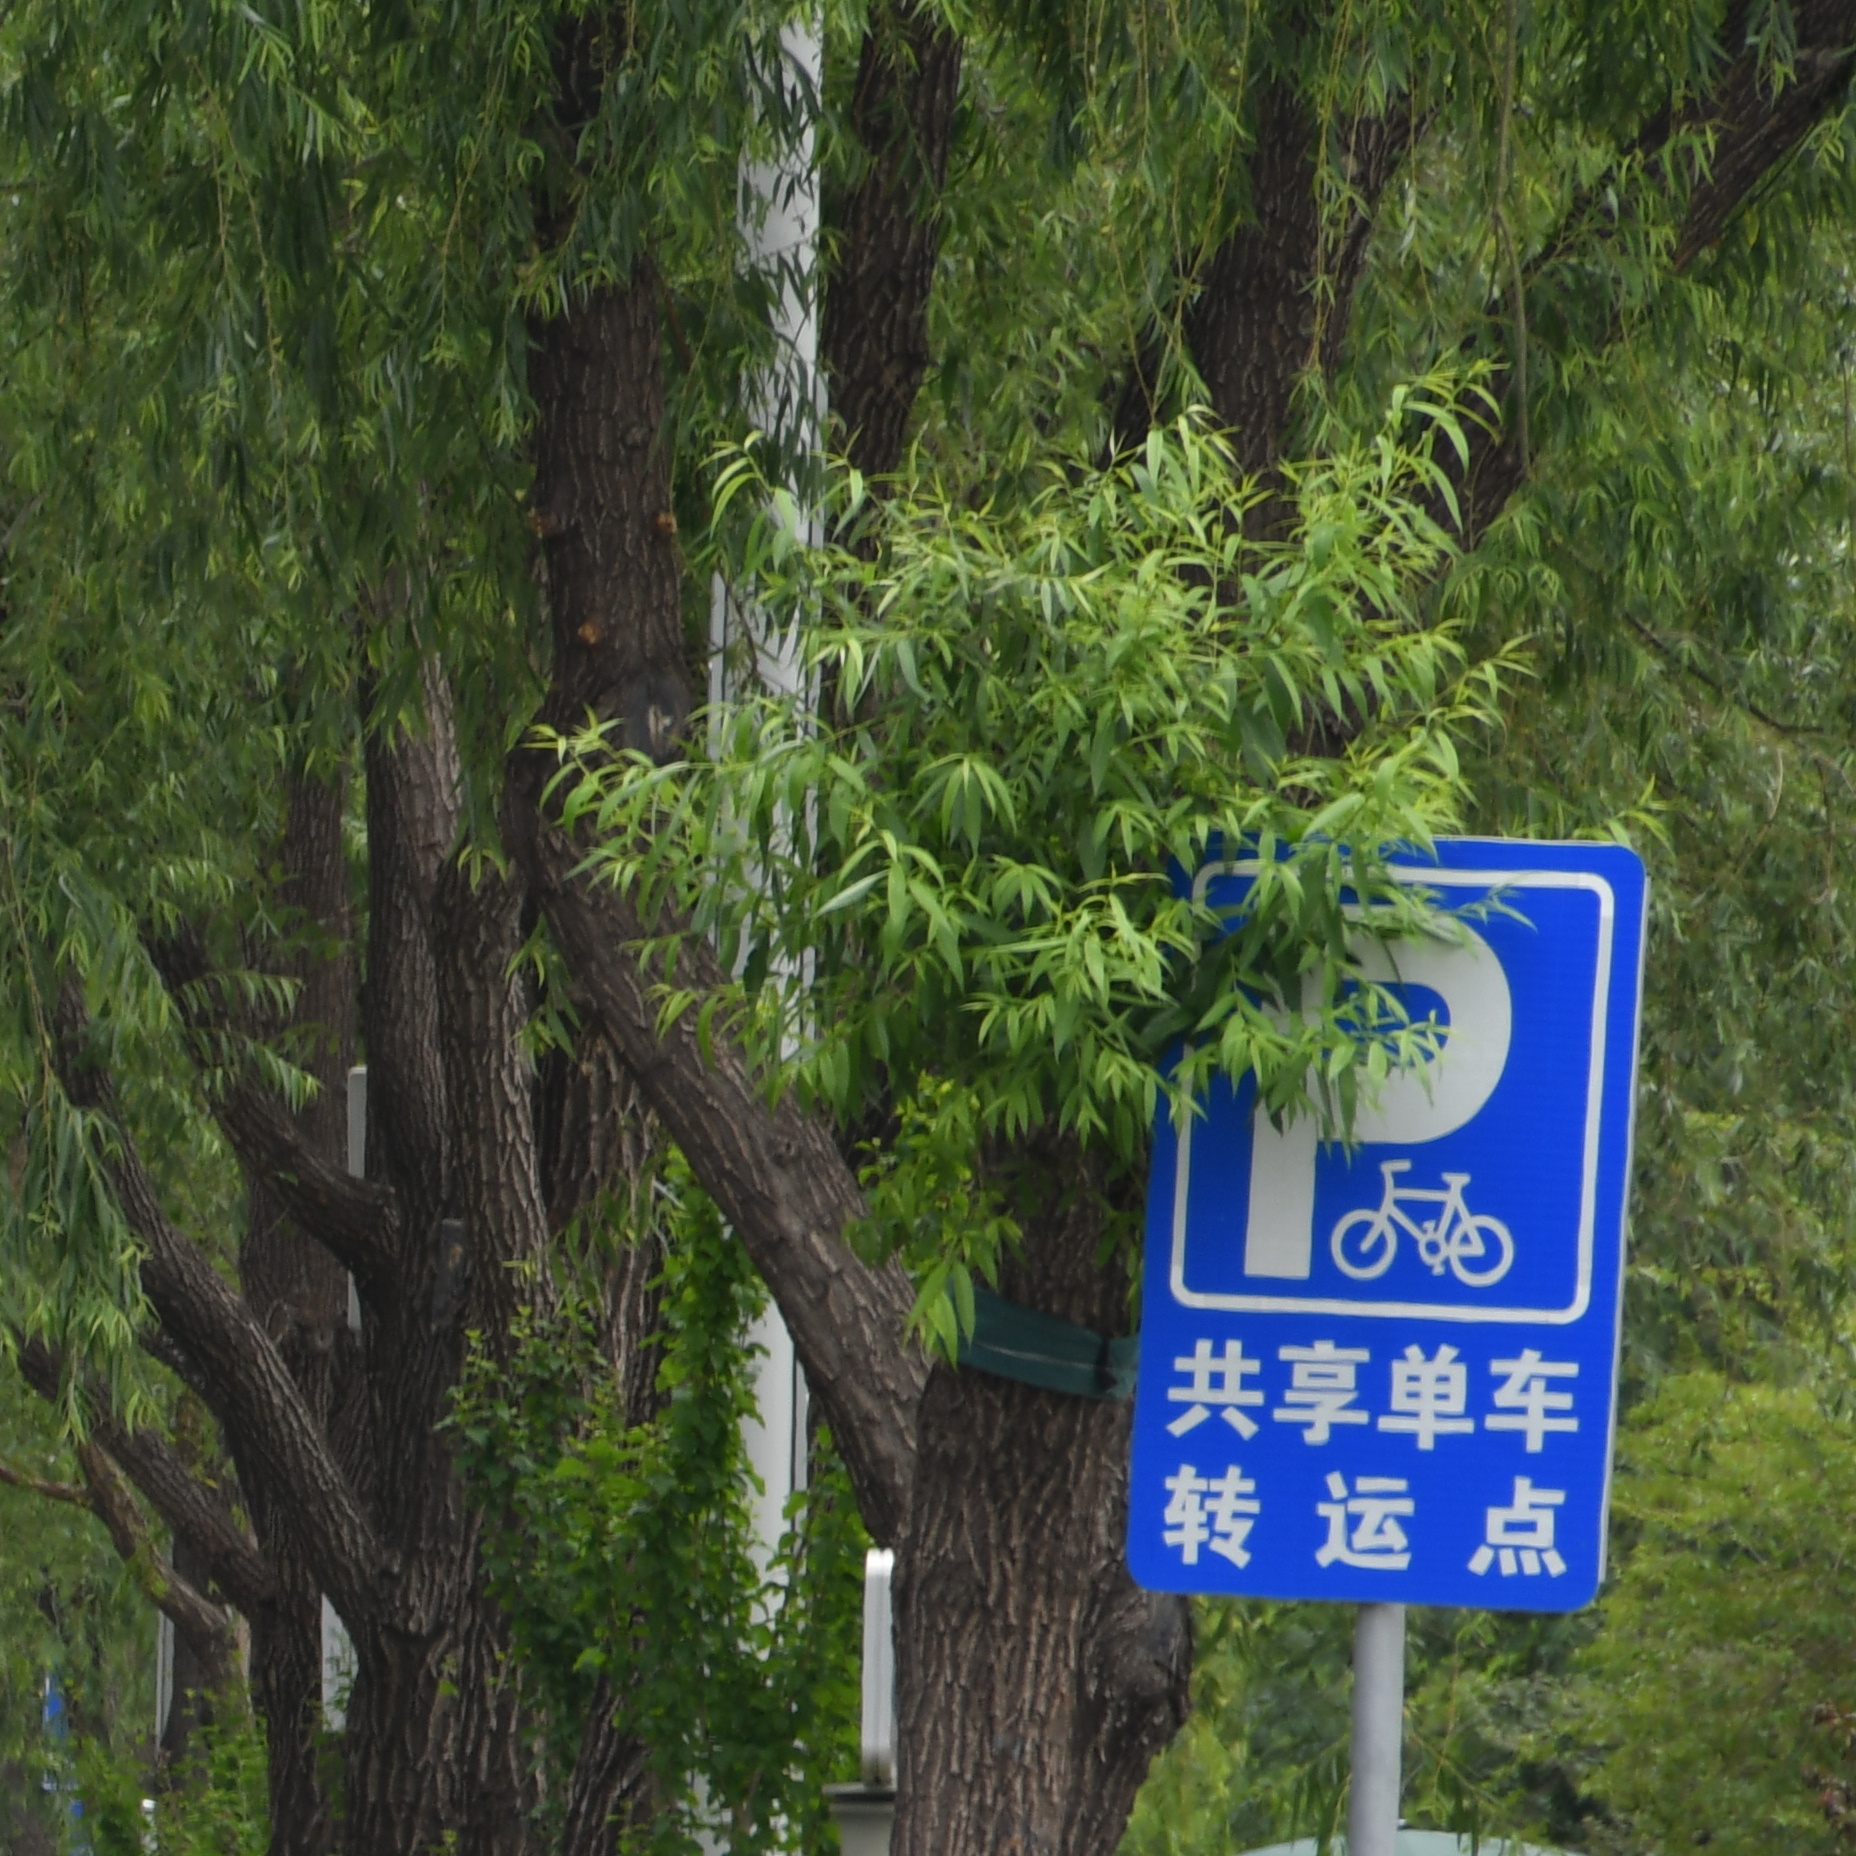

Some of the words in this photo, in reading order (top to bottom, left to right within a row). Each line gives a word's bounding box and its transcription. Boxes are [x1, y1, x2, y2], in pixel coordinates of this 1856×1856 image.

[1164, 1338, 1580, 1454] 共享单车
[1161, 1464, 1568, 1579] 转运点
